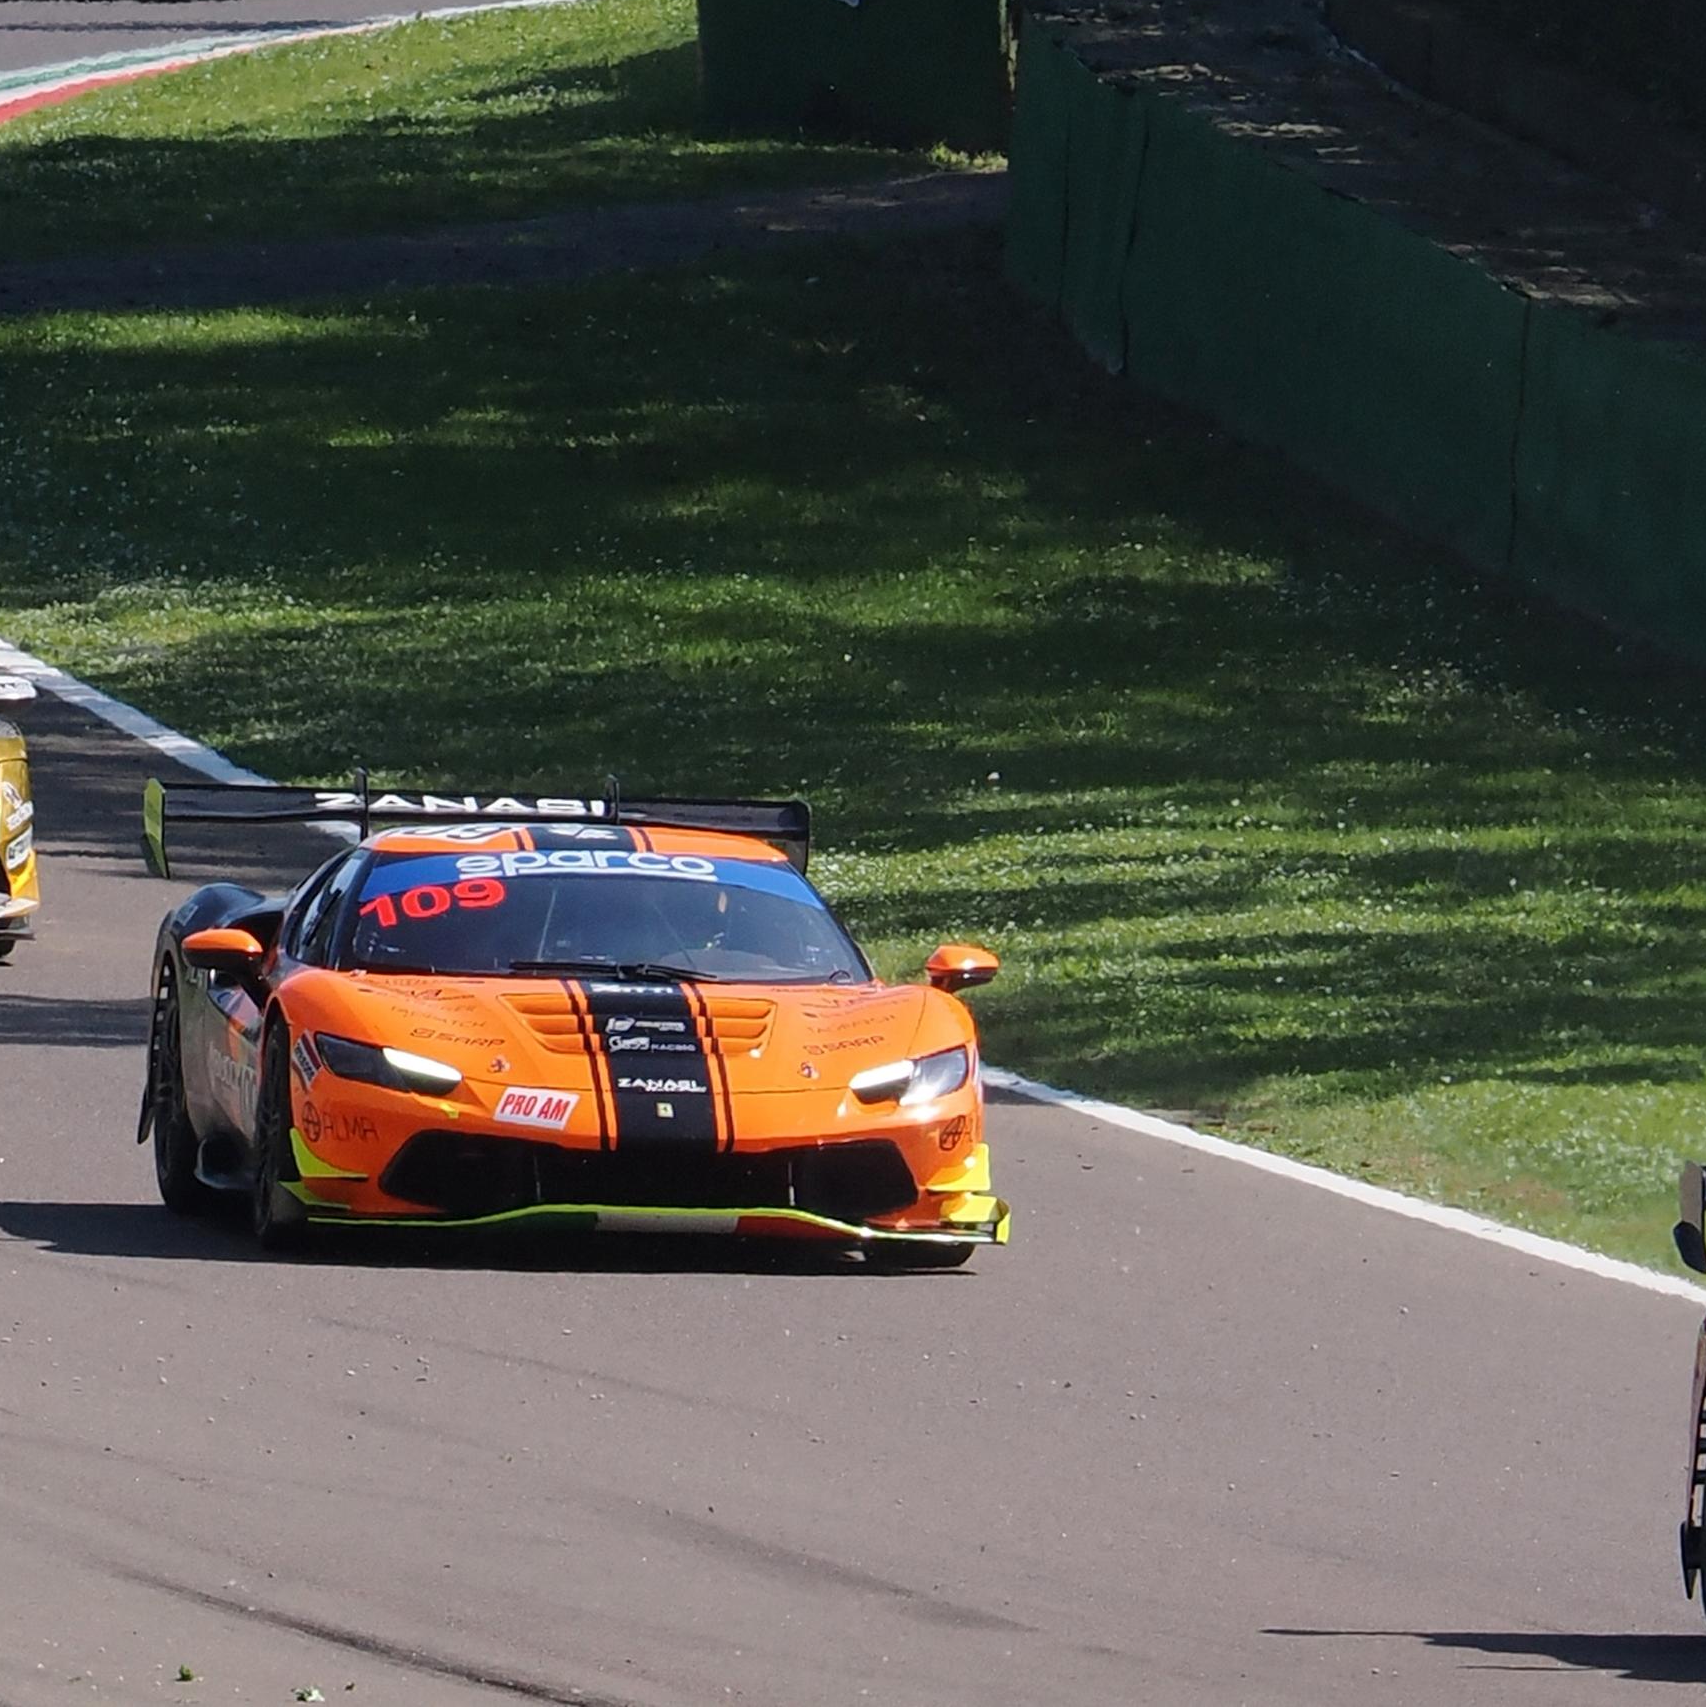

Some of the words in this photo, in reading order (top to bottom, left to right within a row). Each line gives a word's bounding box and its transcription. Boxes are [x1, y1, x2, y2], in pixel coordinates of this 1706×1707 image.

[313, 791, 606, 817] ZANASI
[455, 849, 719, 882] sparco
[357, 877, 507, 929] 109
[499, 1092, 538, 1118] PRO
[536, 1096, 573, 1124] AM
